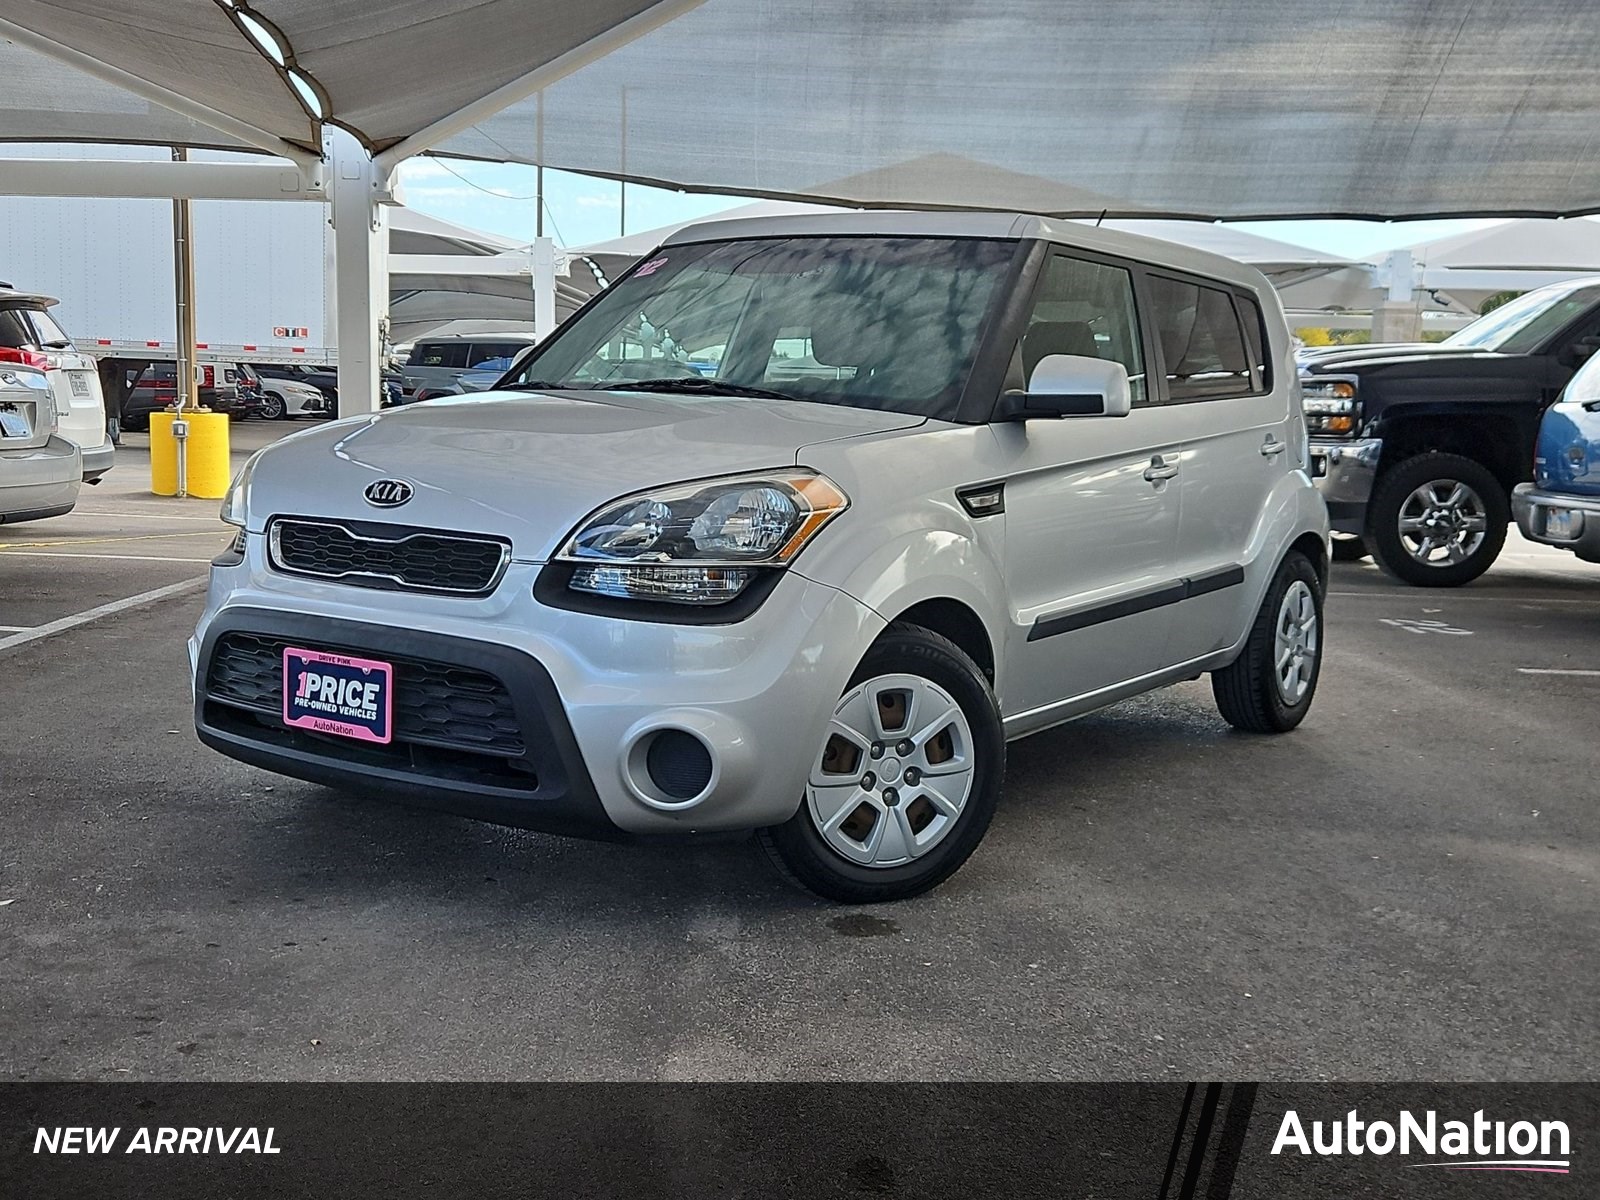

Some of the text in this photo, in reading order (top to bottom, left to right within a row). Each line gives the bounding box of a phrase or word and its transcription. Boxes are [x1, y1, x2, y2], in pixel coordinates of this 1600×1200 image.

[274, 326, 308, 338] CTL
[368, 482, 404, 501] KIA
[318, 654, 351, 666] DRIVE PINK
[296, 671, 380, 711] 1PRICE
[294, 697, 377, 721] PRE-OWNED VEHICLES
[313, 720, 354, 735] AutoNation
